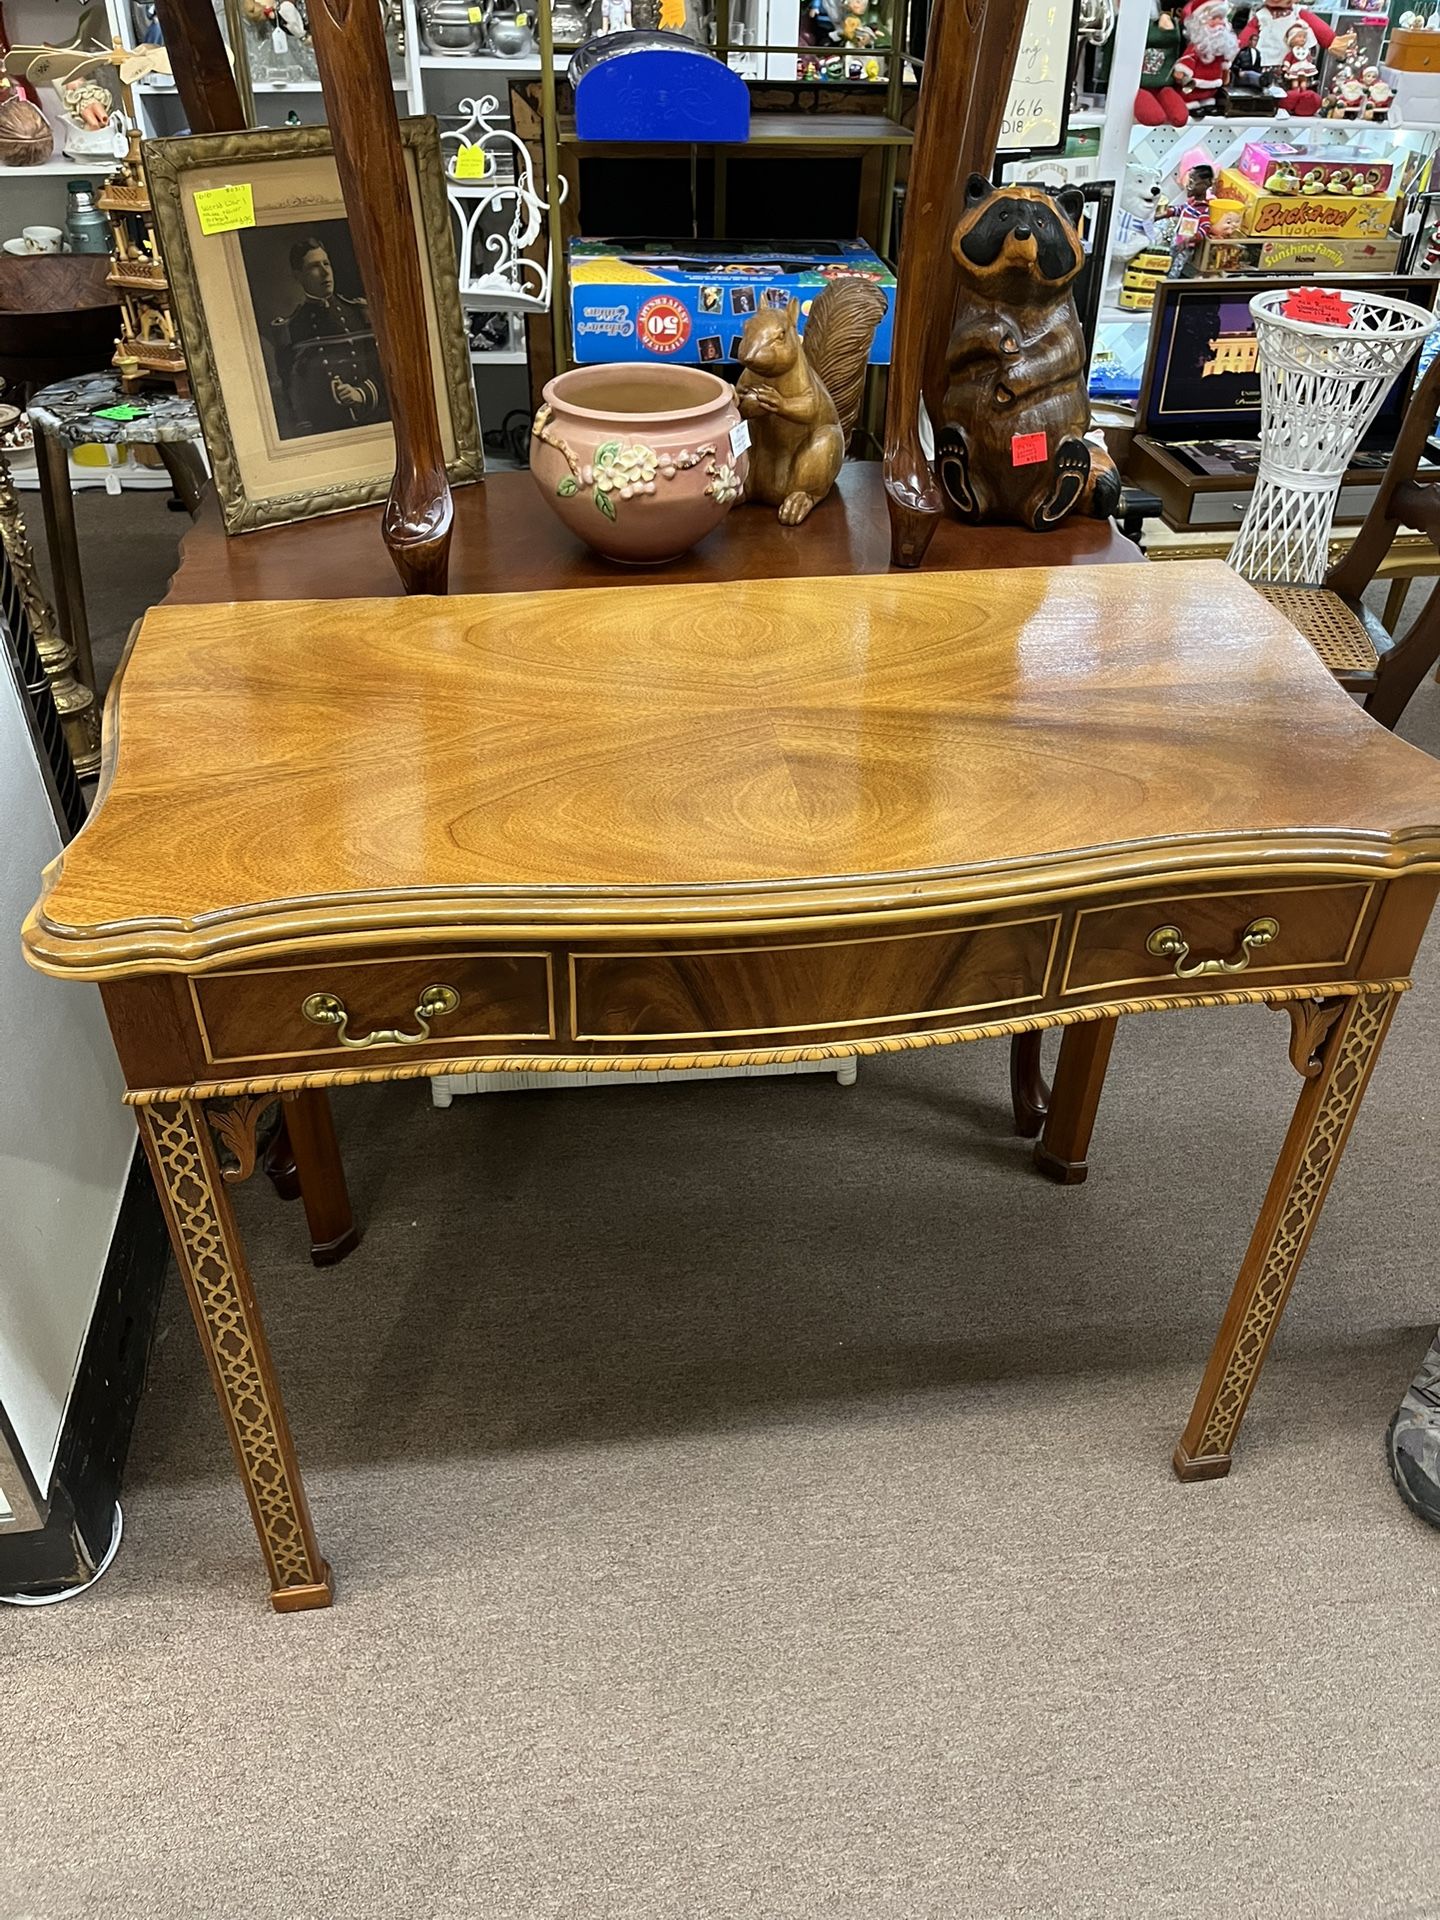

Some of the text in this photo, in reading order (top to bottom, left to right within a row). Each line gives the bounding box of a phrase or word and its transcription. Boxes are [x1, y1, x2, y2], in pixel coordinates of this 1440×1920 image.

[1010, 99, 1043, 117] 1616
[1264, 242, 1314, 267] Sunshine
[1315, 243, 1345, 268] Family
[1295, 255, 1316, 263] Home
[648, 315, 679, 335] 50
